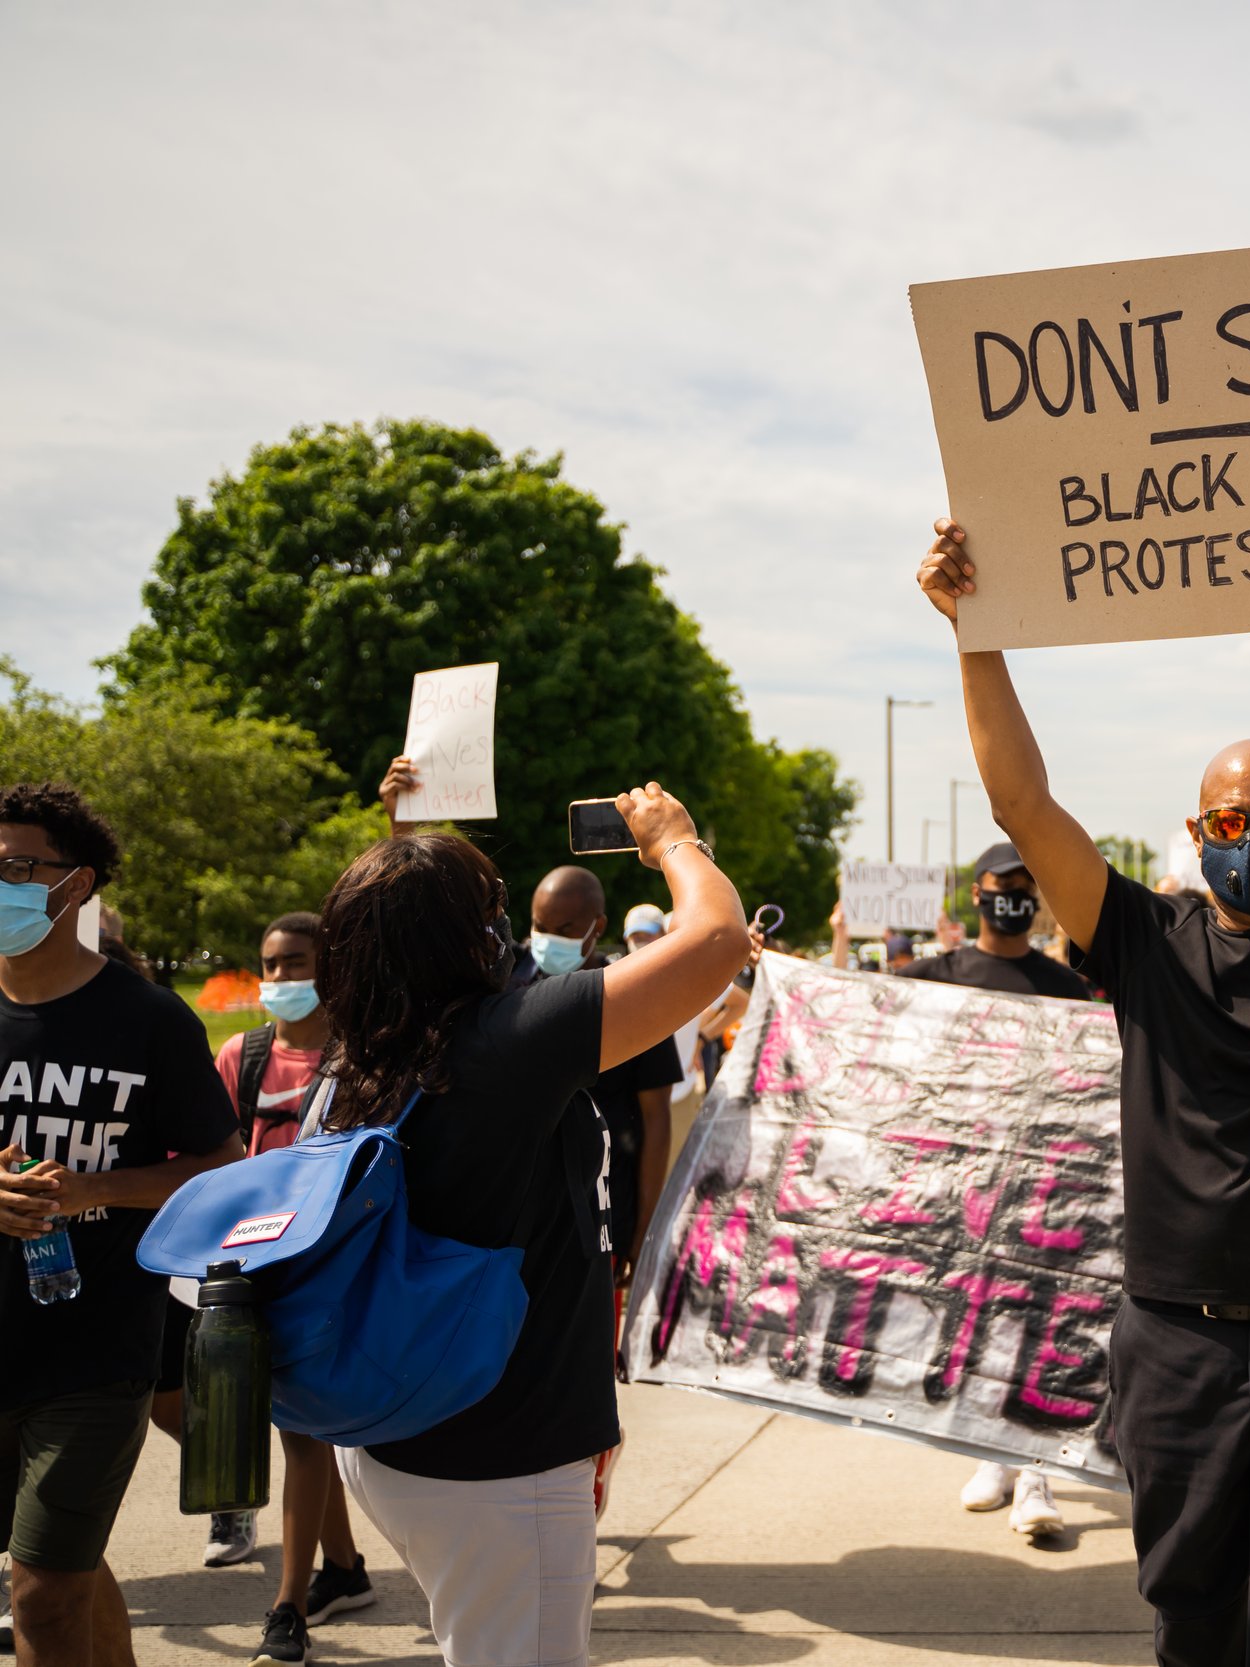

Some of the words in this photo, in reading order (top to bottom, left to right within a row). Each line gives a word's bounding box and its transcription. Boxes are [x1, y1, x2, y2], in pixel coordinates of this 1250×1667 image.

[974, 300, 1183, 422] DON'T
[1059, 451, 1245, 527] BLACK
[415, 681, 489, 725] Black
[994, 896, 1035, 917] BLM
[0, 1114, 130, 1175] ATHE
[770, 1113, 1108, 1256] LIVE
[232, 1221, 284, 1237] HUNTER
[650, 1178, 1112, 1432] MATTE
